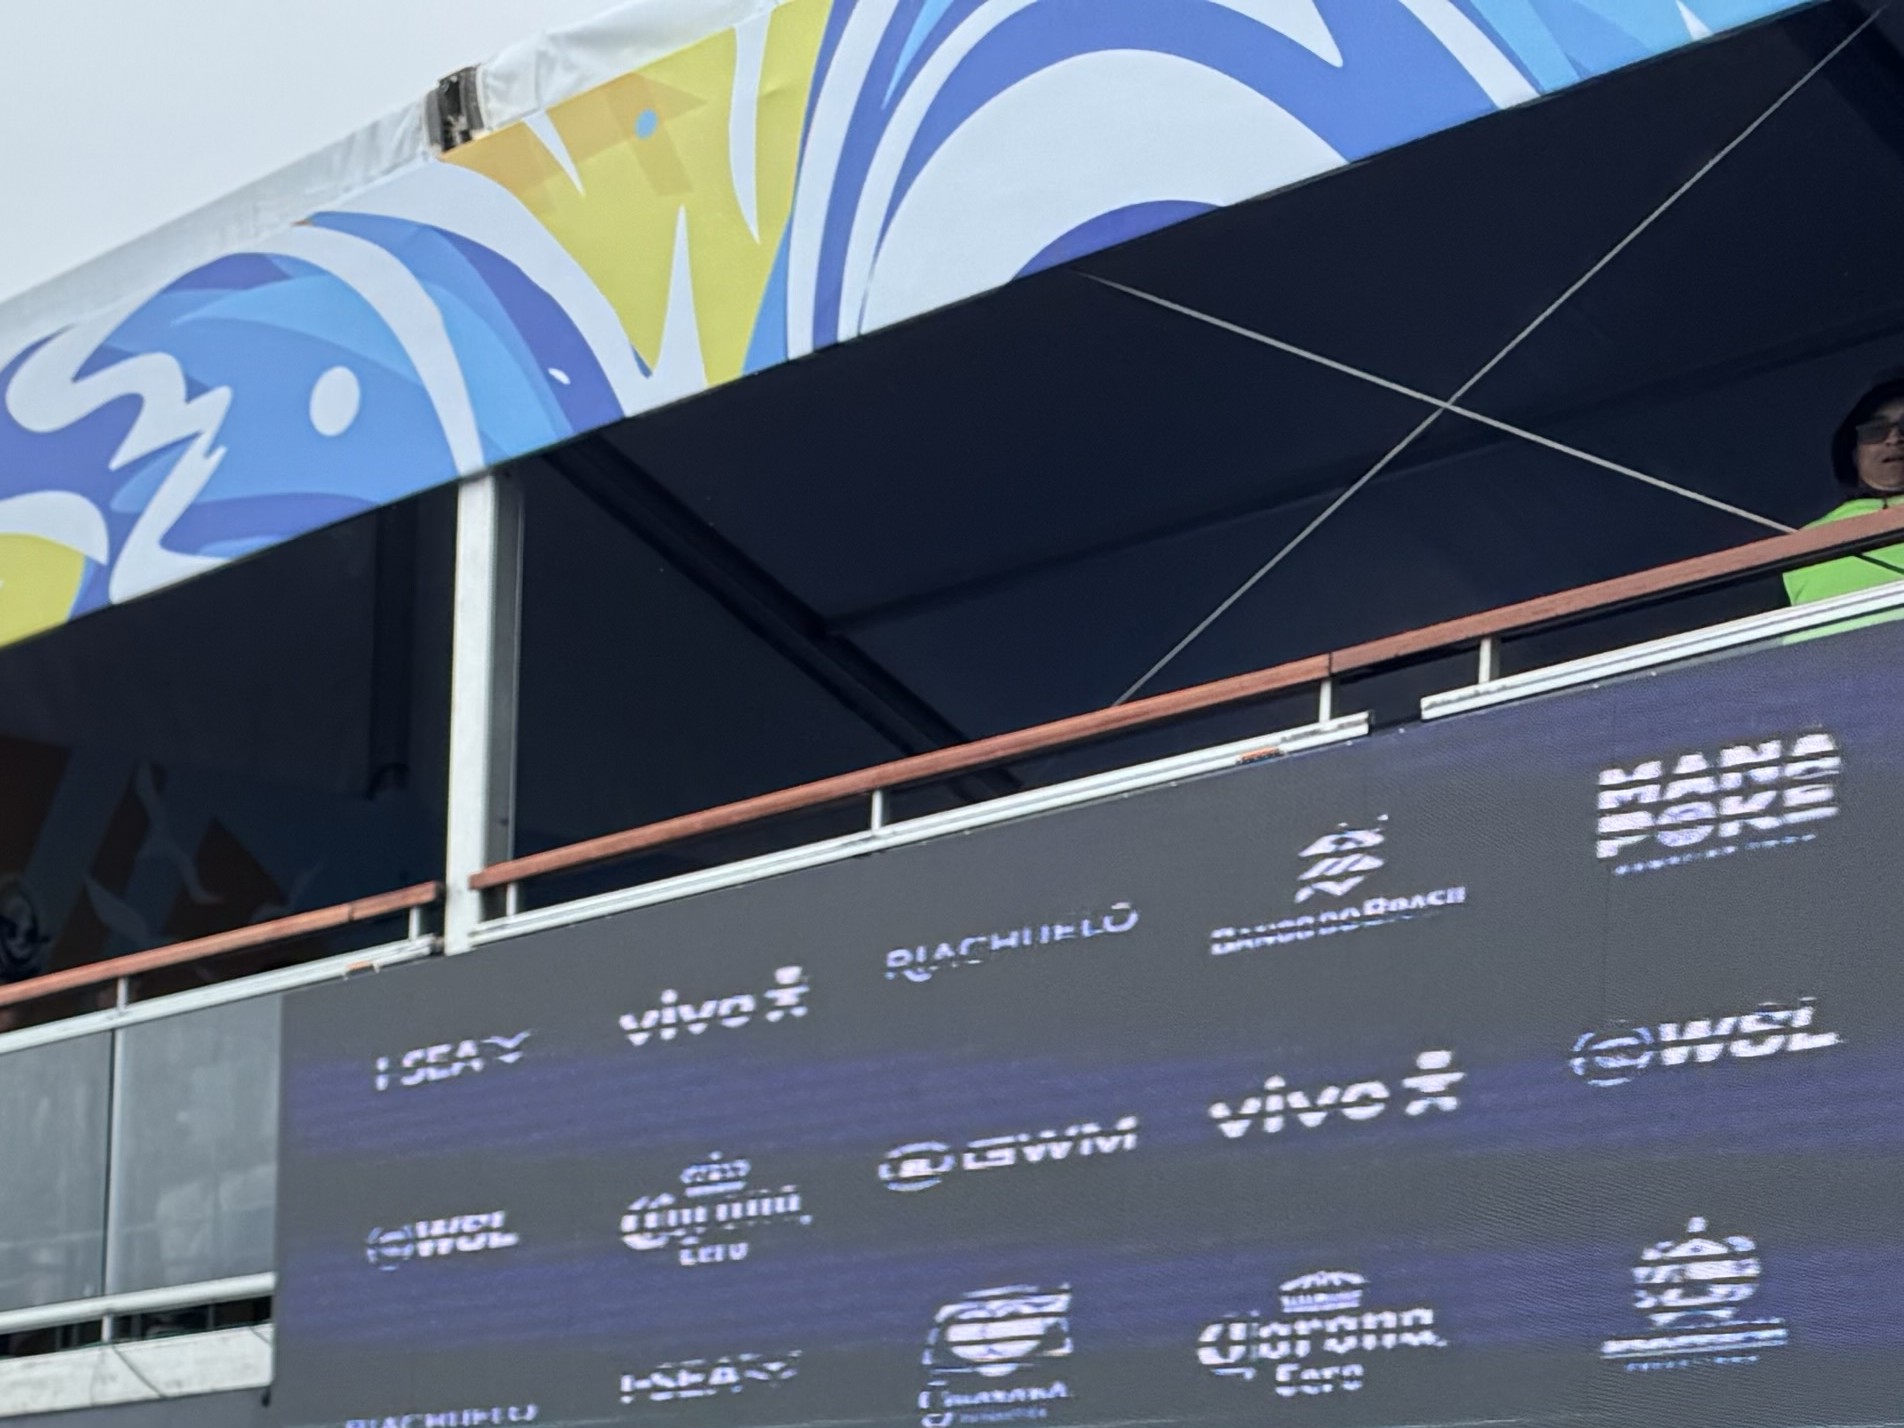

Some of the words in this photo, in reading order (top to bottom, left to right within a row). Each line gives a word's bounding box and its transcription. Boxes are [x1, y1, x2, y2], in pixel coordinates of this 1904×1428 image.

[1597, 733, 1842, 810] MANA
[618, 989, 756, 1047] vivo
[1658, 997, 1845, 1066] WSL
[1208, 1075, 1391, 1140] vivo
[962, 1114, 1139, 1171] GWM
